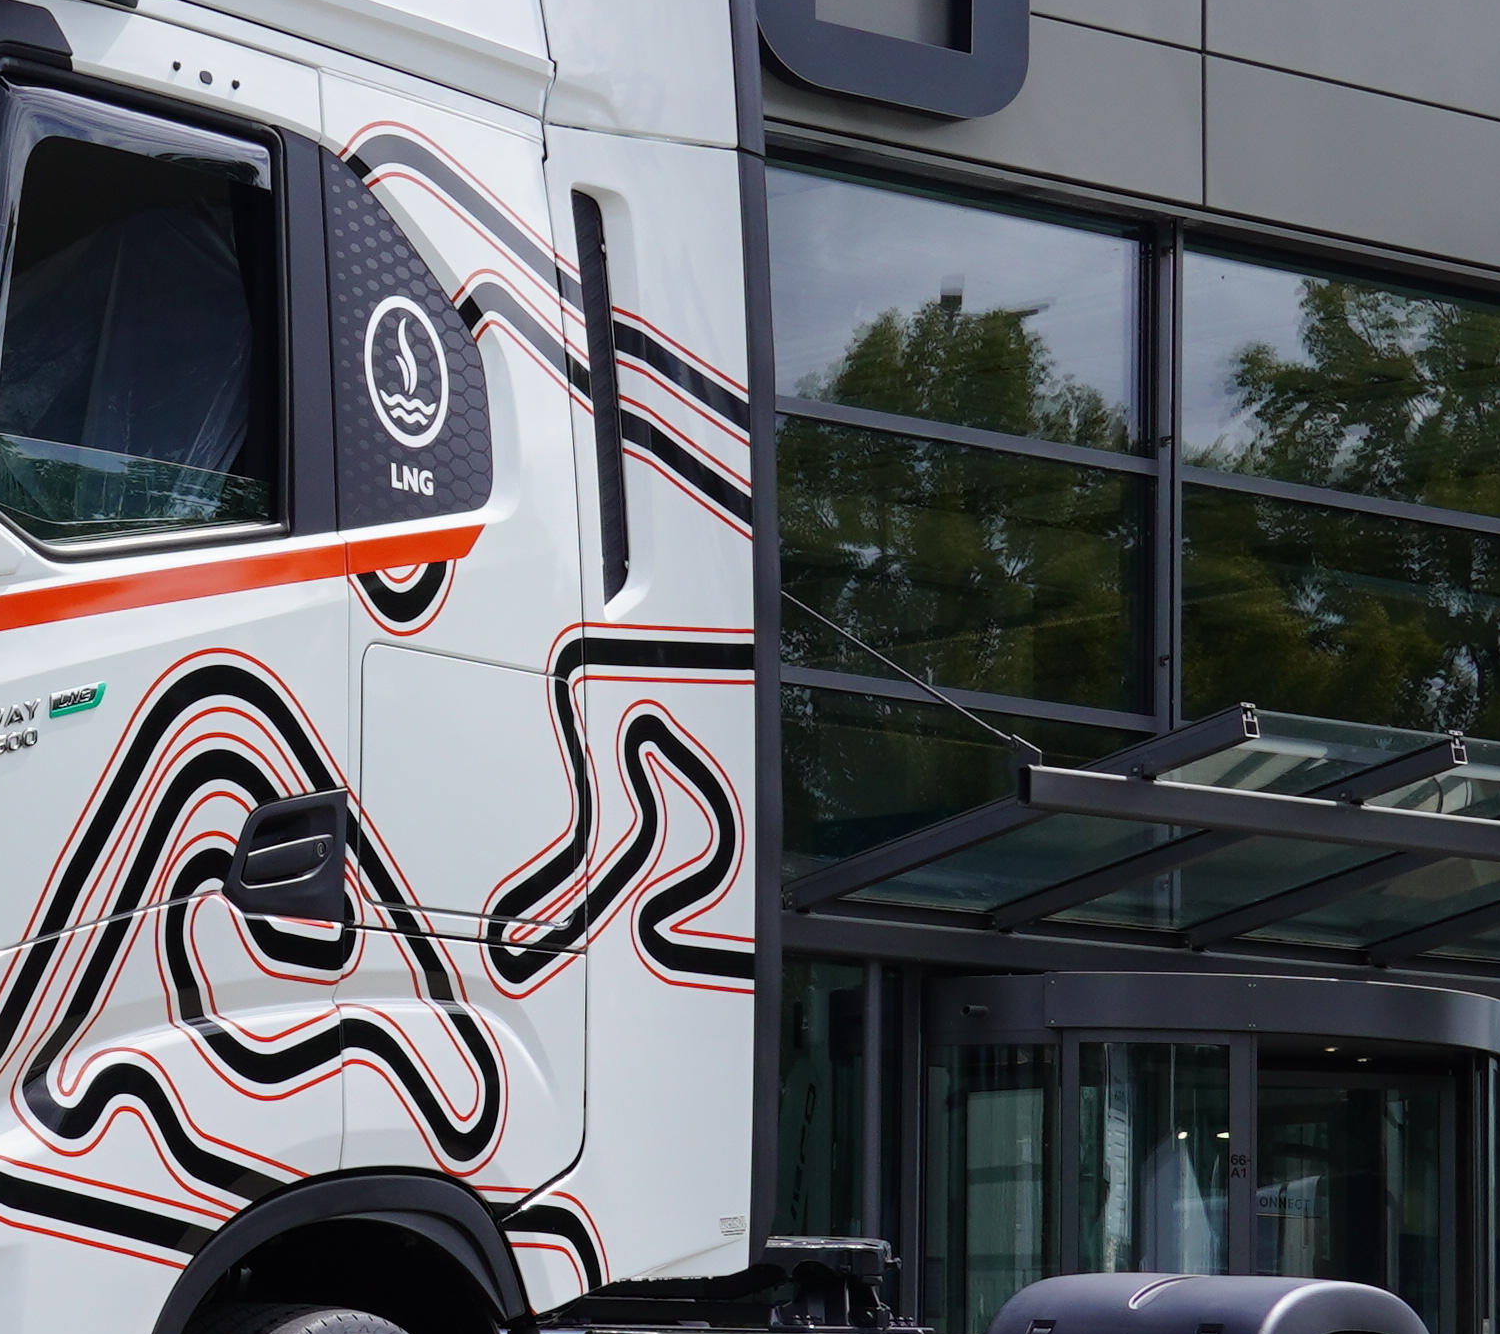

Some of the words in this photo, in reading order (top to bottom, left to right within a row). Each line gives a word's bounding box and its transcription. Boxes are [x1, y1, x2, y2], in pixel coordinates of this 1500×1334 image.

[390, 462, 434, 496] LNG
[59, 687, 93, 708] LNG
[1230, 1154, 1251, 1166] 66-
[1230, 1168, 1248, 1179] A1
[1259, 1197, 1311, 1211] ONNECT
